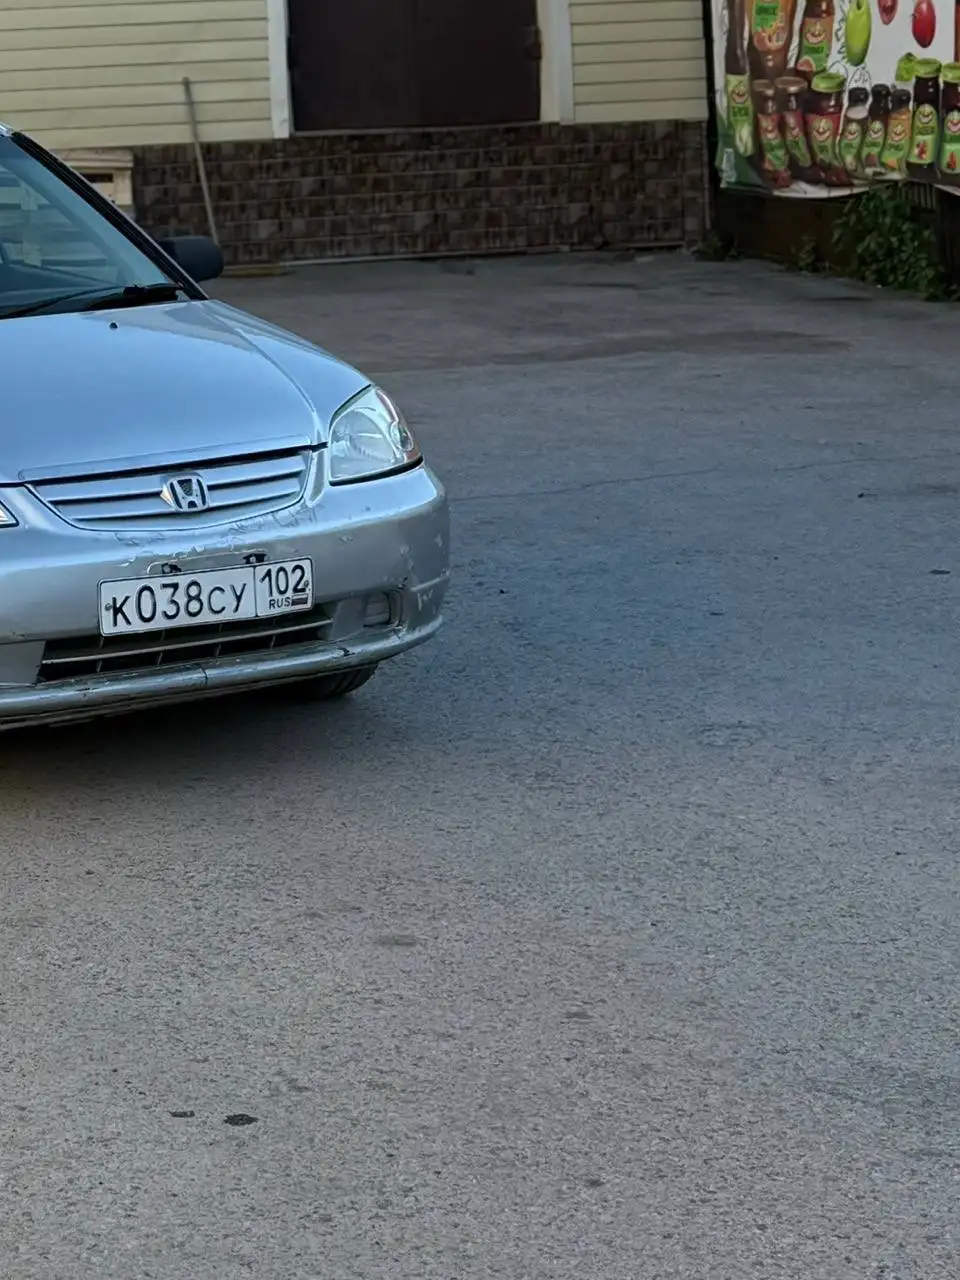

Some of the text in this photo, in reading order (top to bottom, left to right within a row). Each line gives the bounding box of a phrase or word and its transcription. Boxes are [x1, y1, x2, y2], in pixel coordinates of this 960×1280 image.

[111, 564, 307, 628] К038СУ 102
[268, 596, 291, 610] RUS
